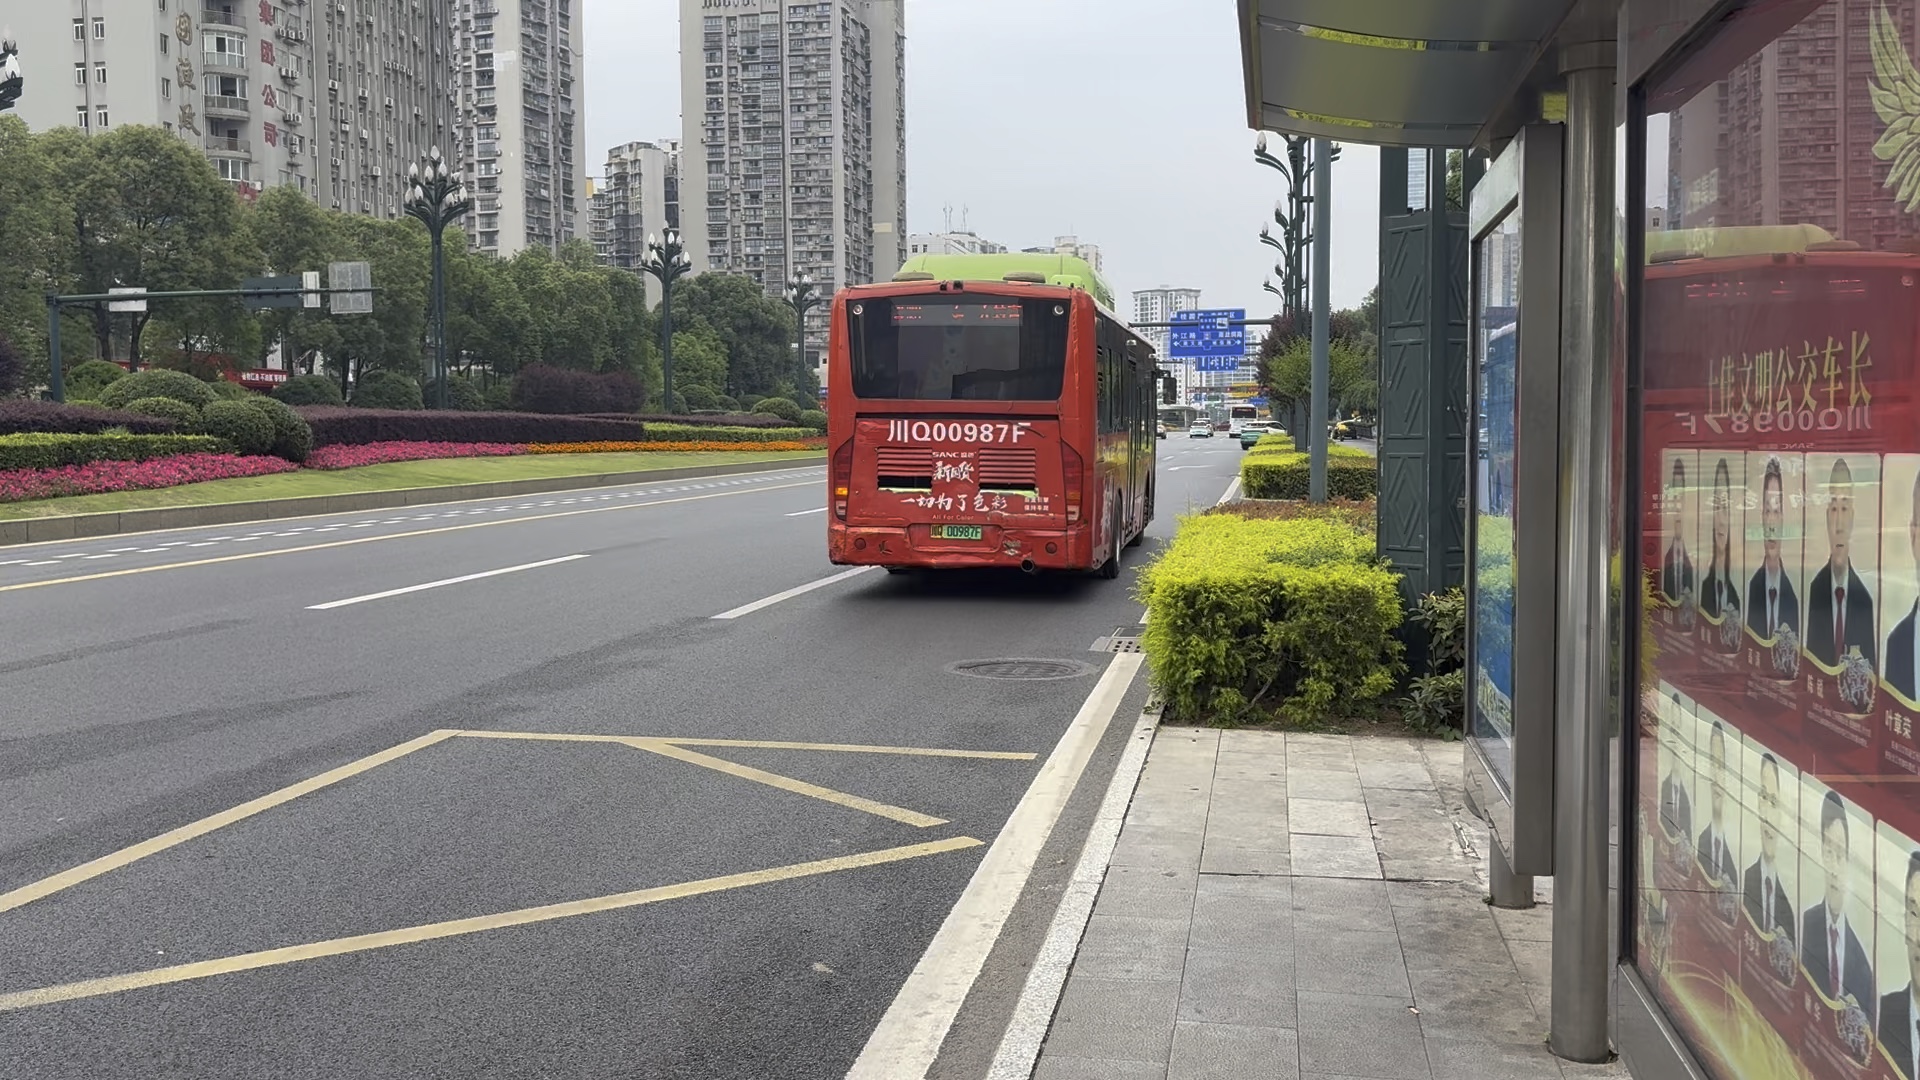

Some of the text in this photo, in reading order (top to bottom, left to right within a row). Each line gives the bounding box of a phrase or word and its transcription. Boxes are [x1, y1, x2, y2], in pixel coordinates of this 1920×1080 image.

[259, 0, 278, 147] 集团公司
[887, 419, 1031, 443] 川Q00987F
[900, 493, 1008, 512] 一切为了色彩
